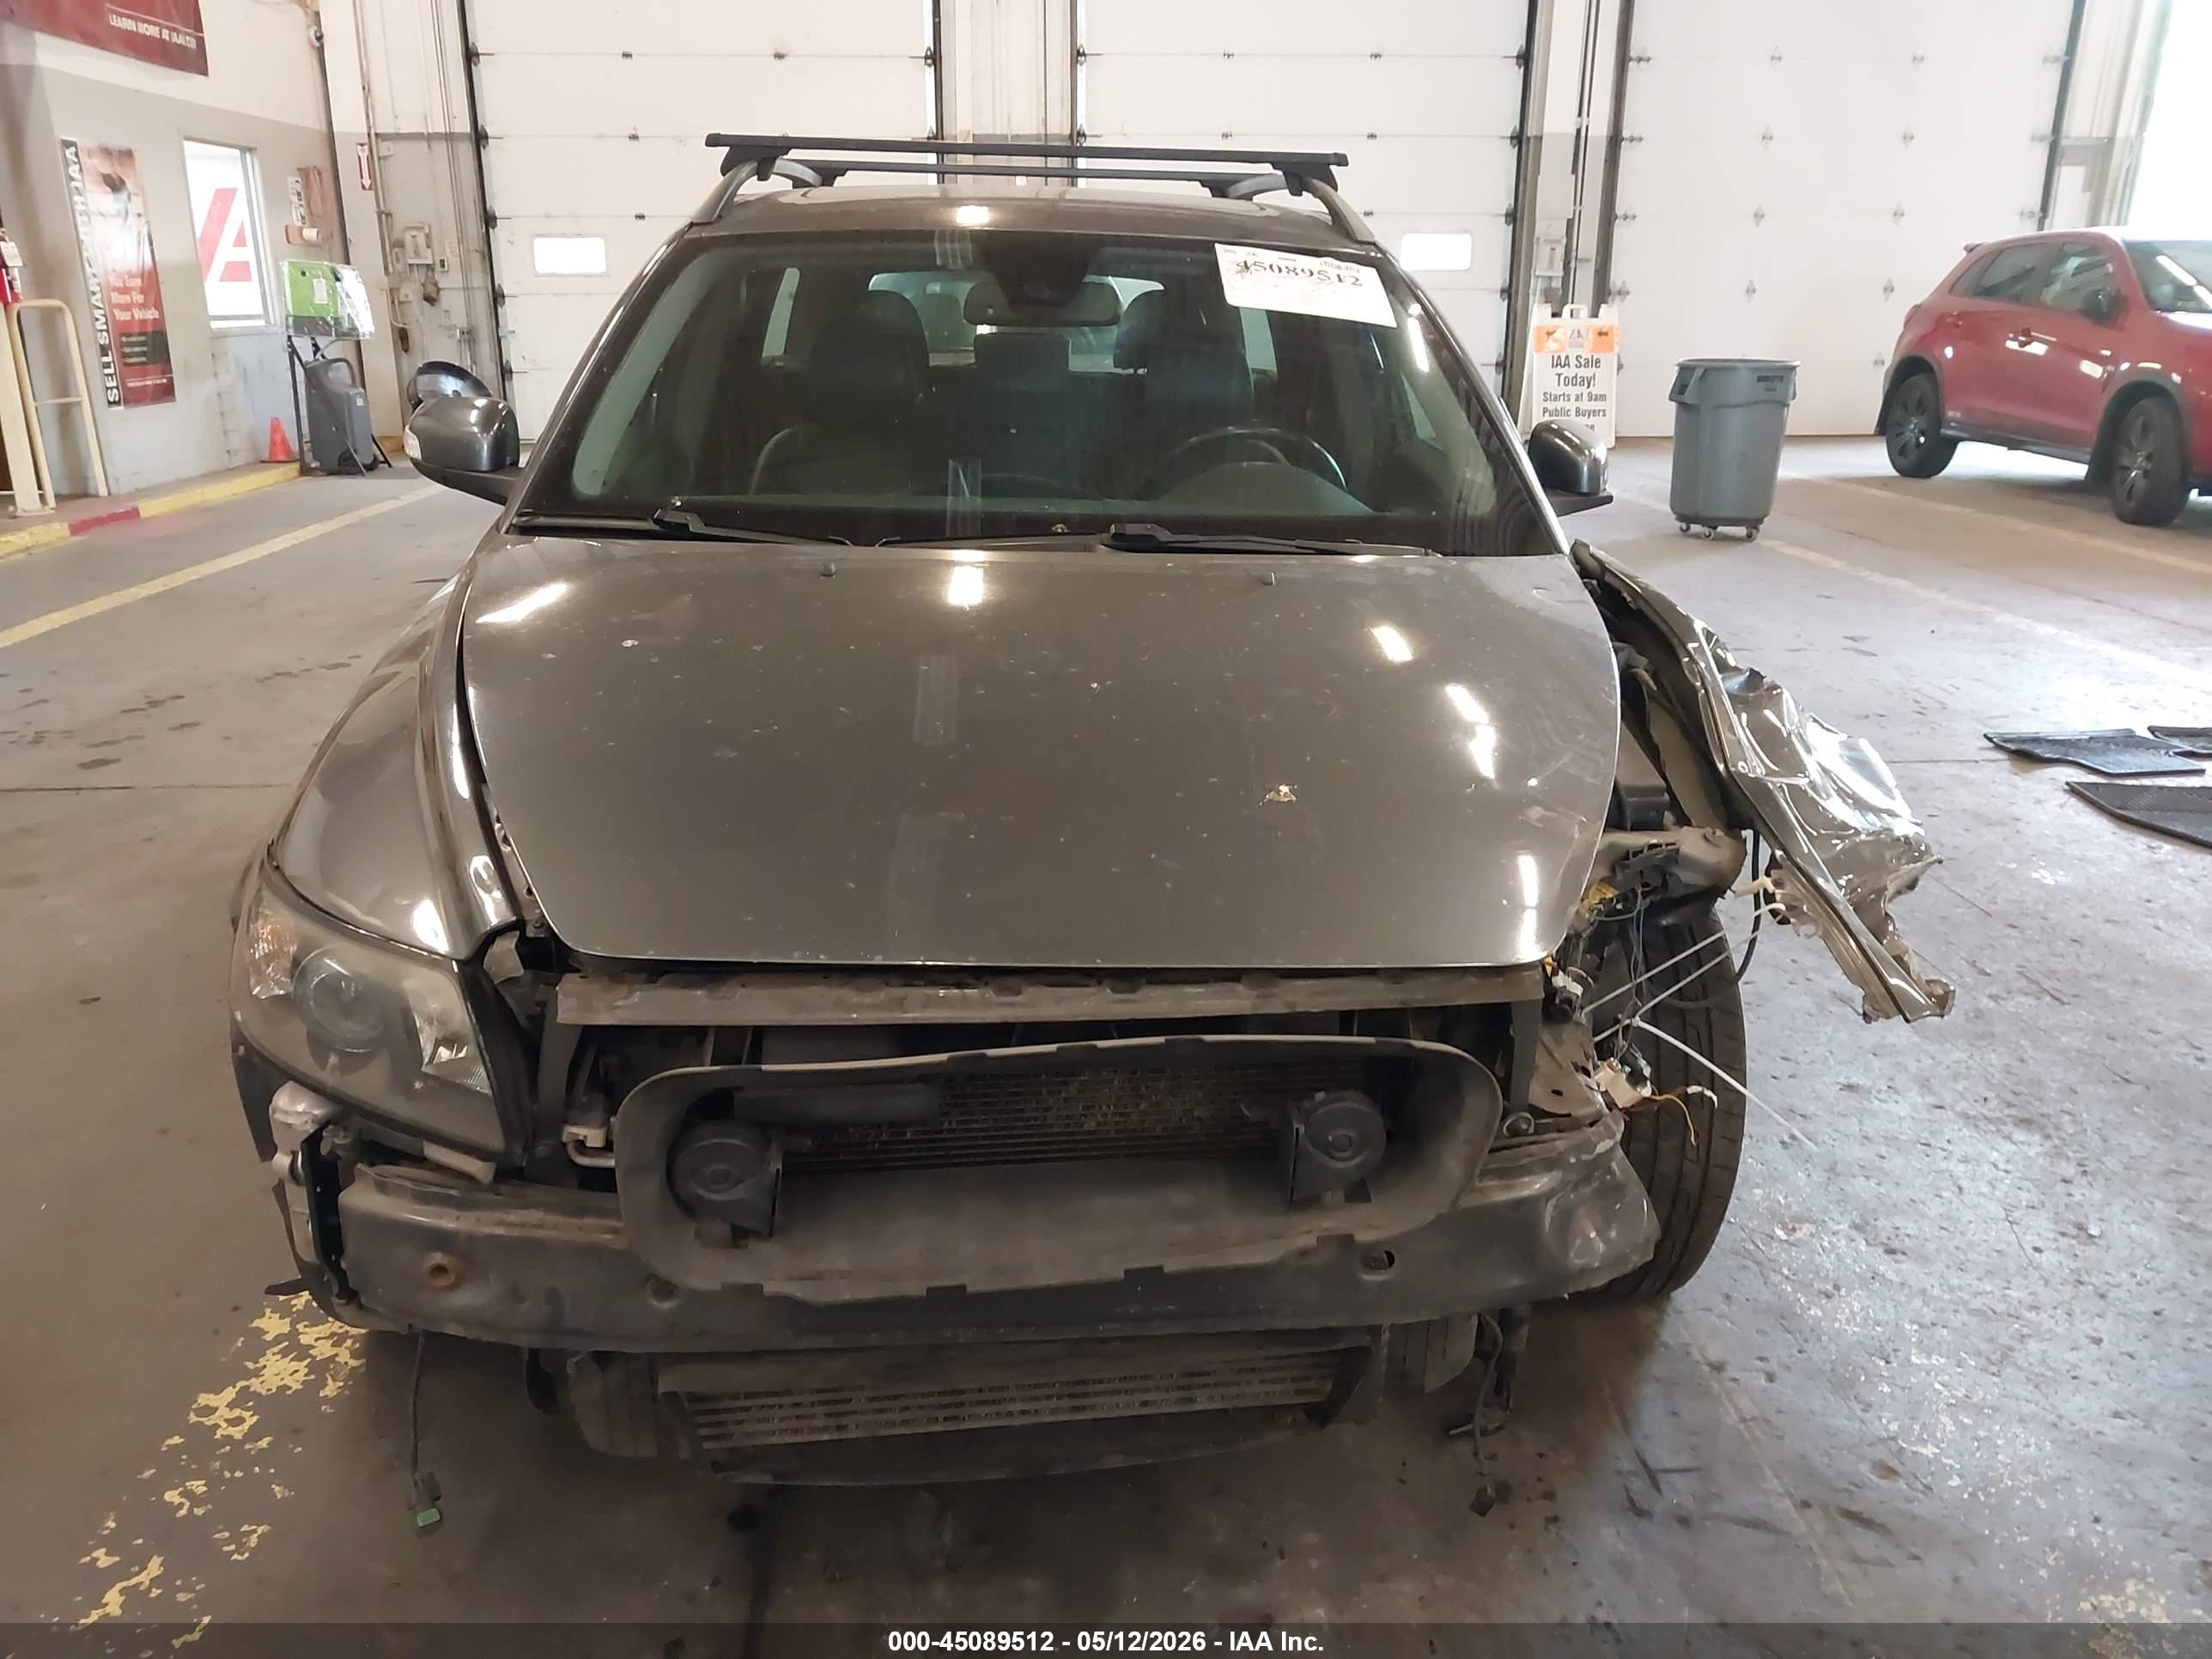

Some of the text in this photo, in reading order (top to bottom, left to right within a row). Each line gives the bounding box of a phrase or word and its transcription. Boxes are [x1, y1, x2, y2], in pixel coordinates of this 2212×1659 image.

[1551, 355, 1601, 368] IAA Sale
[101, 350, 119, 403] SELL
[1555, 373, 1595, 388] Today!
[1542, 391, 1607, 403] Starts at 9am
[1542, 406, 1607, 419] Public Buyers
